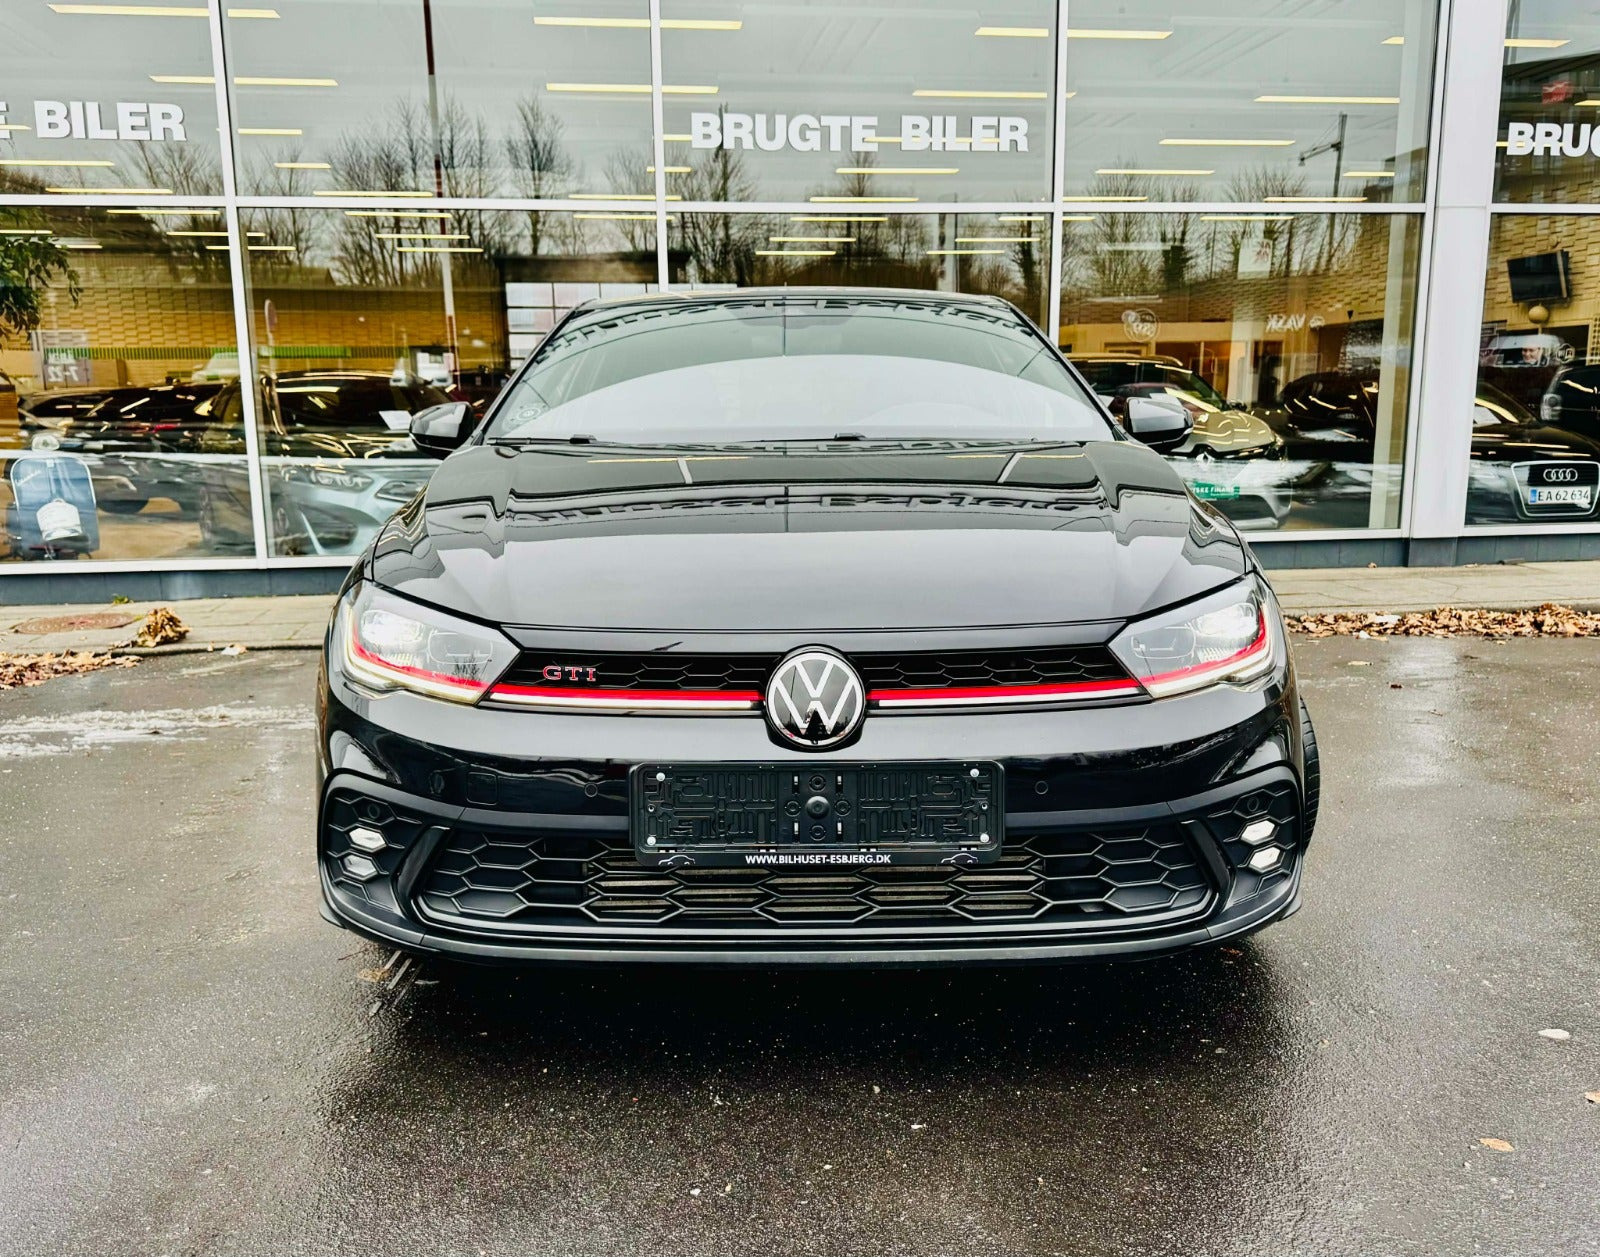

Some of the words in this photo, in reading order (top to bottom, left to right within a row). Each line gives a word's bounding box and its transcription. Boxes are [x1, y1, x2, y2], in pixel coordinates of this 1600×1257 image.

[33, 100, 187, 141] BILER
[690, 111, 879, 152] BRUGTE
[900, 114, 1030, 152] BILER
[1555, 490, 1569, 502] 62
[542, 665, 597, 682] GTI
[745, 854, 892, 864] WWW.BILHUSET-ESBJERG.DK
